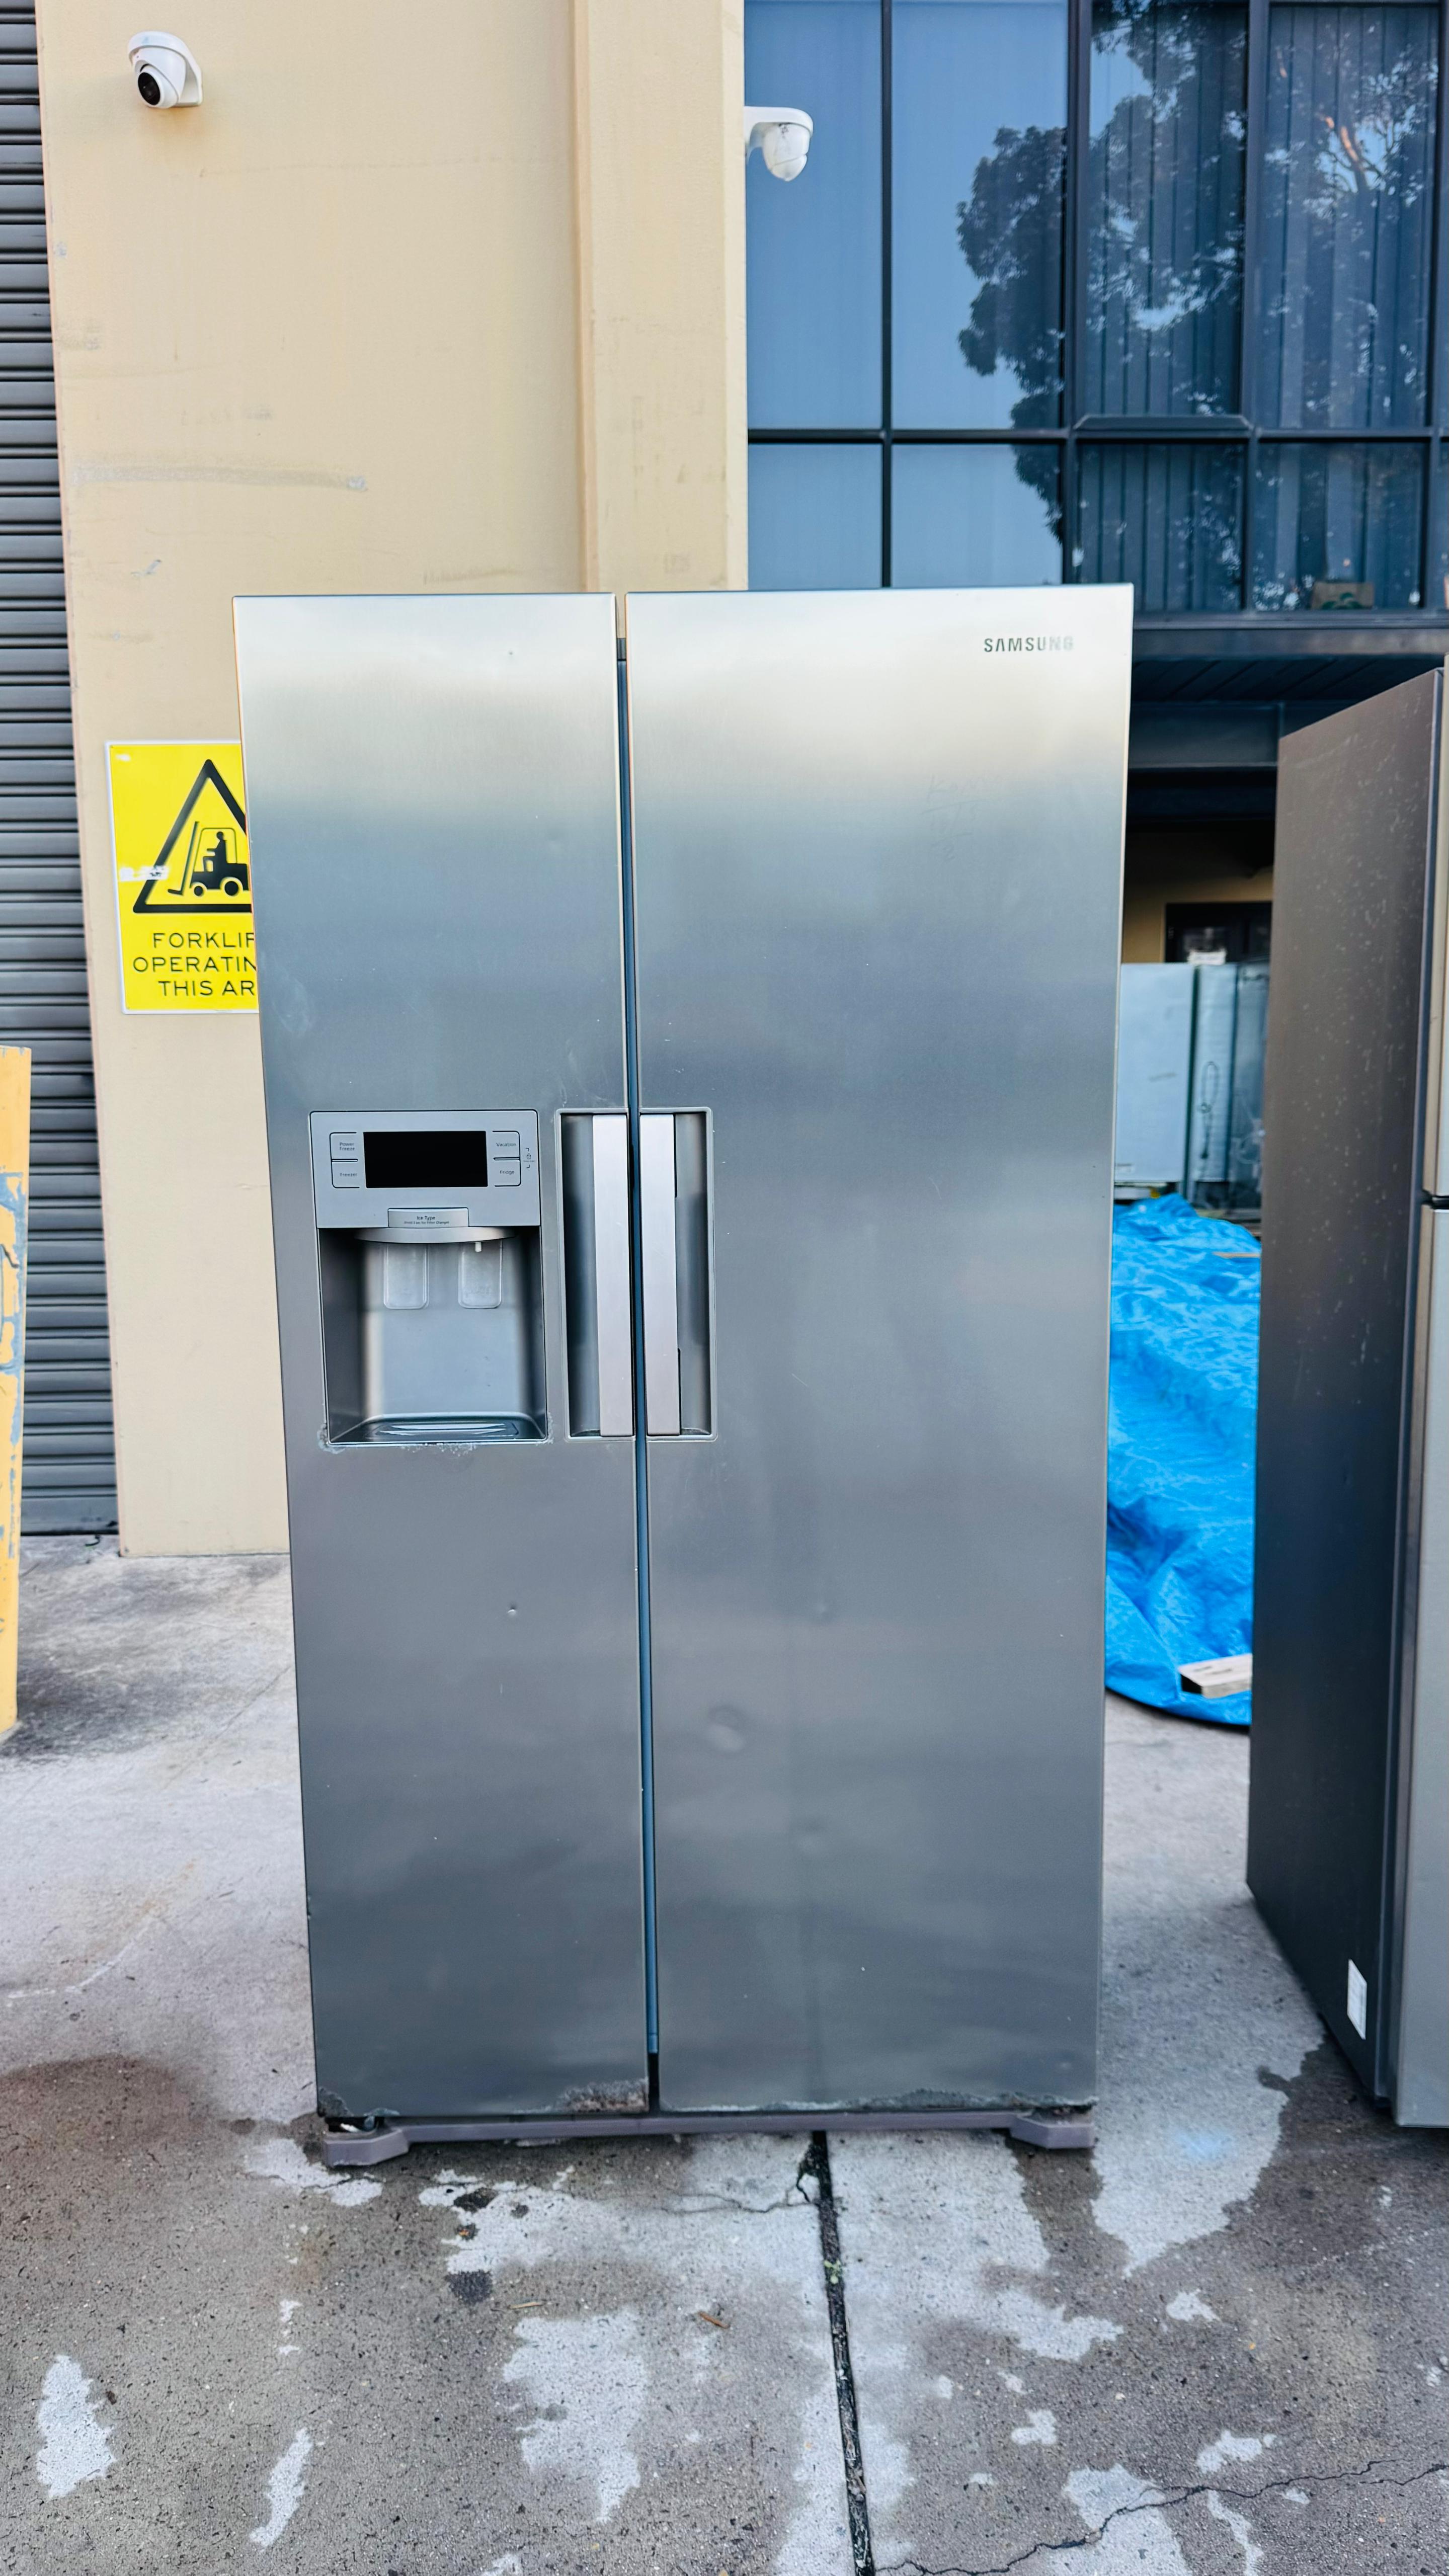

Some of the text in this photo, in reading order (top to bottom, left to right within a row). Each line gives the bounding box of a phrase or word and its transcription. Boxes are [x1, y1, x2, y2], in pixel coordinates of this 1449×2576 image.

[984, 636, 1074, 653] SAMSUNG
[152, 932, 255, 948] FORKLIF
[133, 956, 257, 972] OPERATIN
[158, 981, 255, 996] THIS AR
